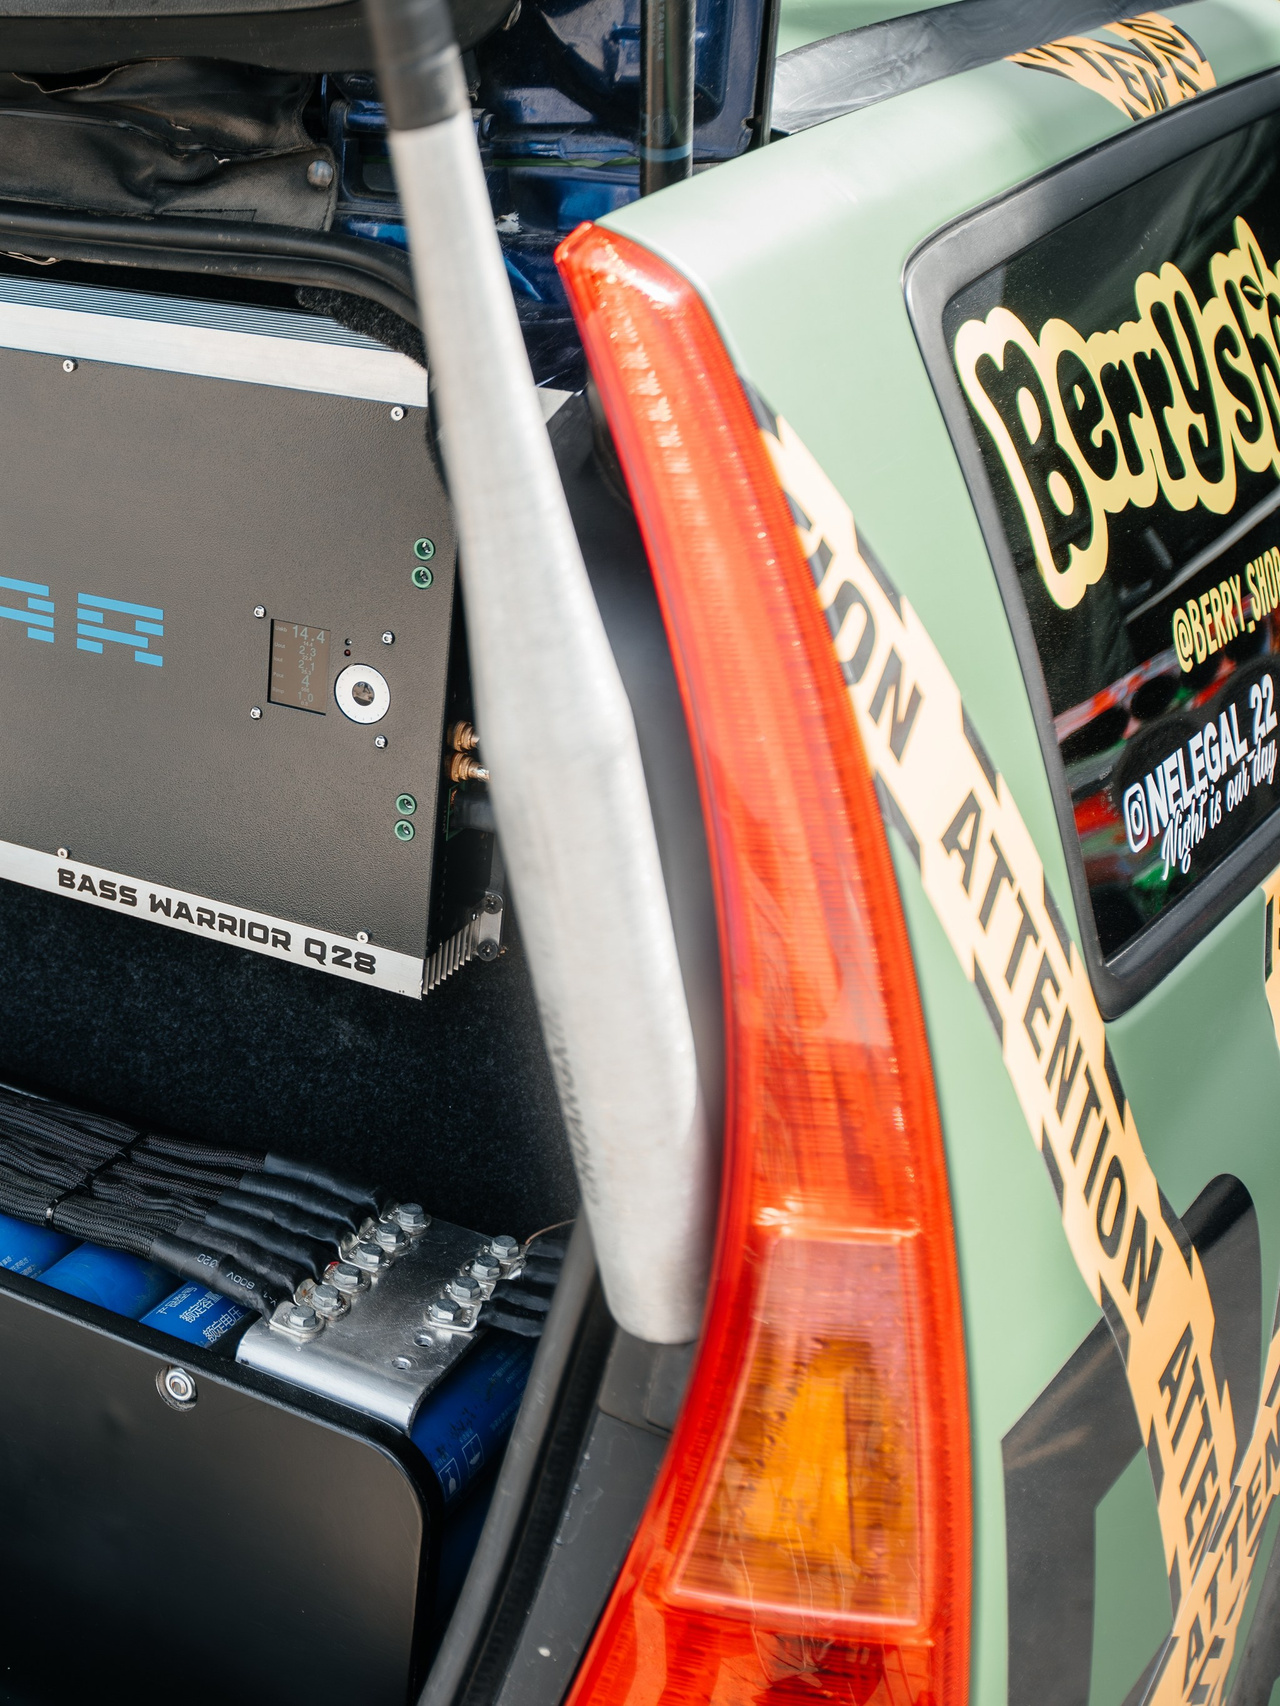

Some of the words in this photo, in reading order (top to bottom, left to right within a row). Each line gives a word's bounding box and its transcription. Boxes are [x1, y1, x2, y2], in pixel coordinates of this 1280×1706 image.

[292, 624, 326, 645] 14.4
[298, 645, 317, 658] 2.3
[297, 659, 316, 672] 2.1
[301, 674, 310, 688] 4
[297, 690, 314, 703] 1.0
[1161, 791, 1208, 881] Night
[1208, 785, 1222, 829] is
[1227, 759, 1251, 813] our
[1252, 737, 1278, 787] day
[57, 868, 138, 908] BASS
[148, 894, 292, 953] WARRIOR
[304, 937, 377, 976] Q28
[940, 789, 1163, 1327] ATTENTION
[226, 1271, 256, 1290] 600V
[202, 1305, 246, 1344] 额定电压
